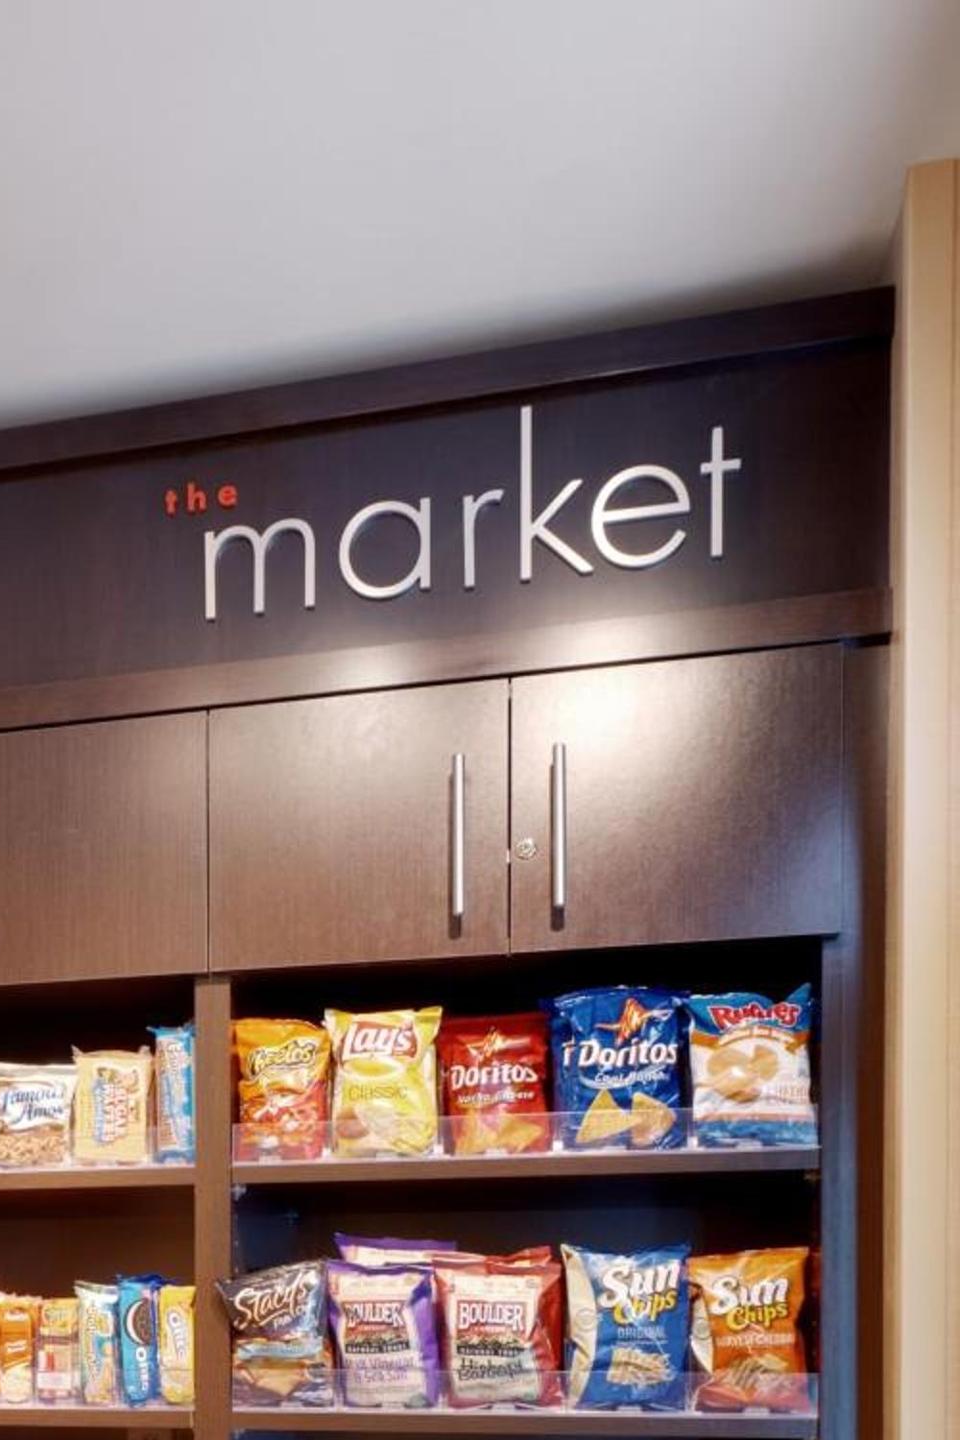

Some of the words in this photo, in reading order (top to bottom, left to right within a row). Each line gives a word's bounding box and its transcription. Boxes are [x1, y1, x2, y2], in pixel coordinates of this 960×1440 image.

[162, 481, 239, 514] the
[203, 405, 742, 620] market
[342, 1021, 418, 1061] Lay's
[578, 1038, 679, 1068] Doritos
[450, 1063, 539, 1090] Doritos
[596, 1259, 680, 1309] Sun
[711, 1275, 789, 1316] Sun
[344, 1303, 405, 1328] BOULDER
[457, 1303, 526, 1331] BOULDER
[613, 1289, 677, 1325] Chips
[726, 1301, 788, 1331] Chips
